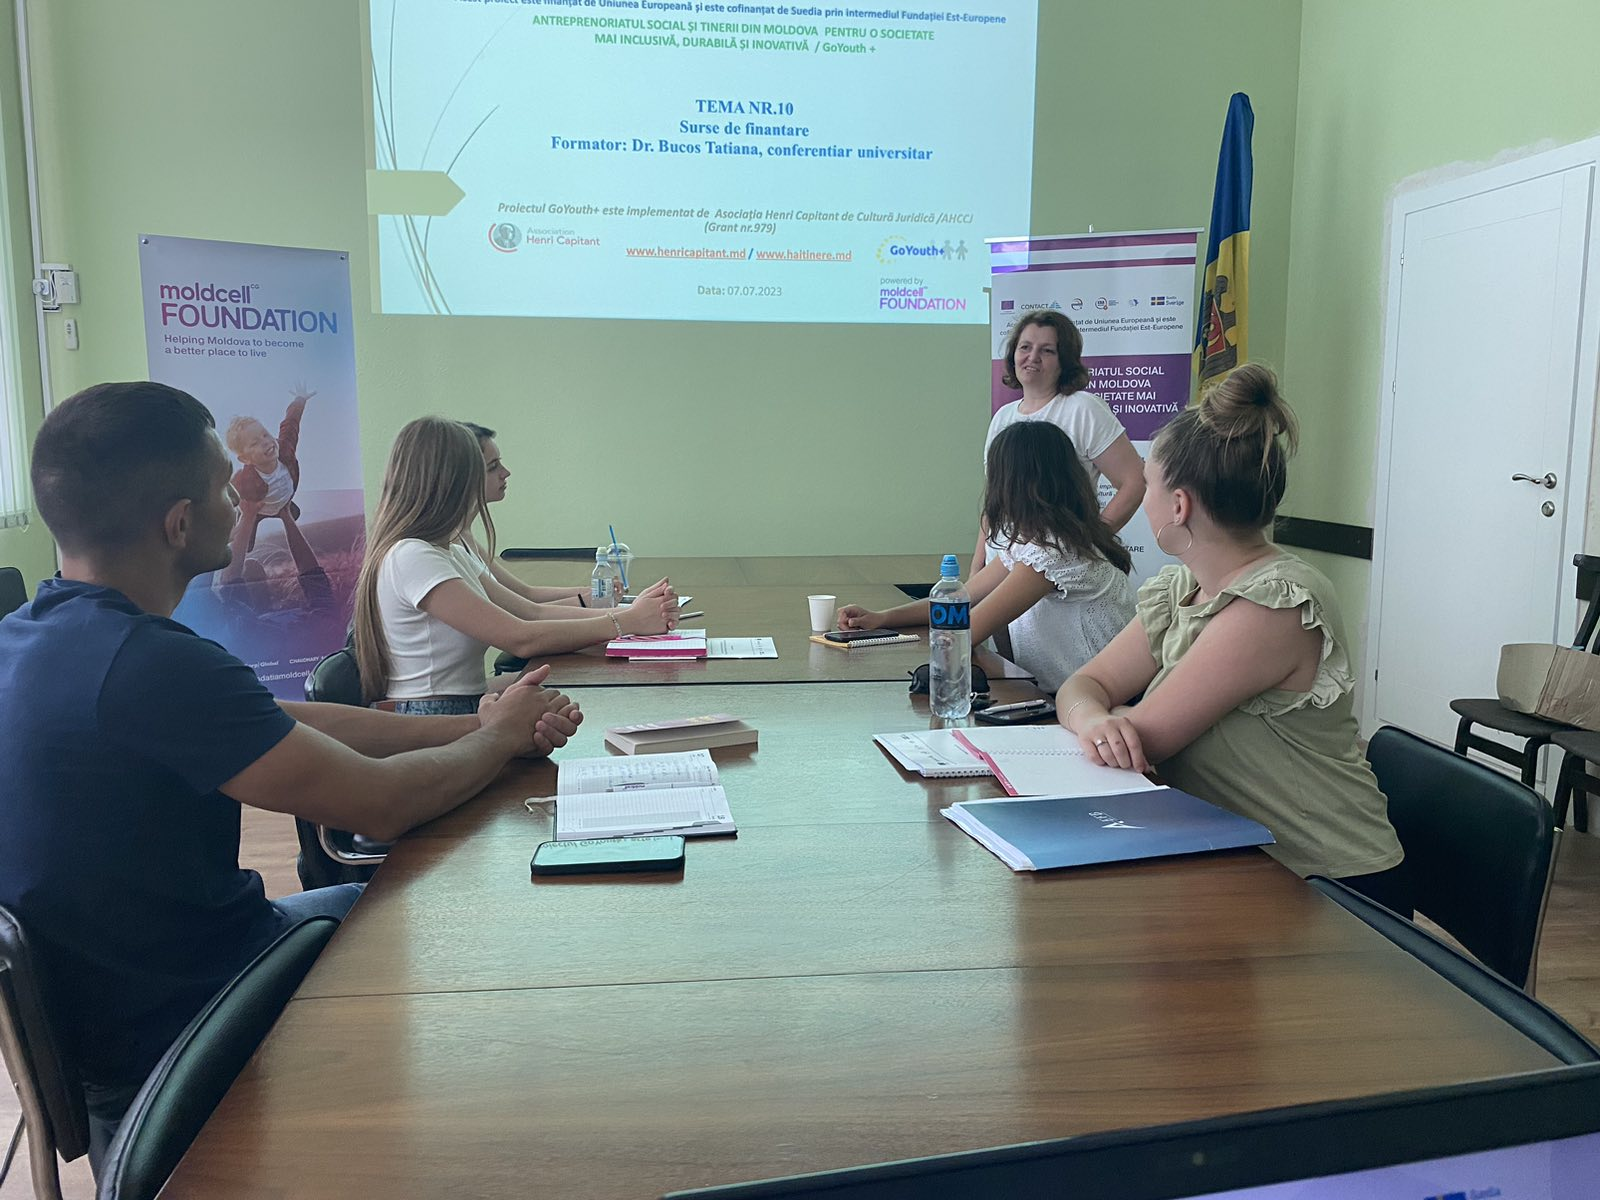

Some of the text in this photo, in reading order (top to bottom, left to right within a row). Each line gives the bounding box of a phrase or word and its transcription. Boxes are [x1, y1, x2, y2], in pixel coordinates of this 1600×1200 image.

[599, 0, 639, 9] Uniunea
[641, 0, 692, 12] Europeană
[704, 5, 725, 13] este
[777, 6, 789, 15] de
[791, 6, 822, 17] Suedia
[825, 8, 844, 19] prin
[846, 8, 899, 20] intermediul
[946, 13, 1007, 25] Est-Europene
[532, 15, 645, 30] ANTREPRENORIATUL
[647, 19, 686, 31] SOCIAL
[700, 22, 739, 33] TINERII
[741, 24, 761, 34] DIN
[764, 24, 818, 36] MOLDOVA
[825, 27, 867, 38] PENTRU
[870, 28, 878, 39] O
[880, 29, 935, 41] SOCIETATE
[594, 33, 618, 44] MAI
[683, 36, 737, 49] DURABILĂ
[752, 39, 809, 52] INOVATIVĂ
[822, 42, 867, 54] GoYouth
[695, 99, 794, 116] TEMA NR.10
[679, 120, 810, 137] Surse de finantare
[551, 136, 933, 161] Formator: Dr. Bucos Tatiana, conferentiar universitar
[497, 203, 546, 215] Proiectul
[548, 204, 599, 216] GoYouth+
[602, 206, 625, 216] este
[627, 206, 694, 219] implementat
[696, 208, 710, 218] de
[765, 210, 793, 221] Henri
[795, 210, 840, 223] Capitant
[841, 211, 854, 222] de
[856, 212, 895, 223] Cultură
[895, 212, 935, 224] Juridică
[526, 227, 576, 236] Association
[704, 222, 777, 235] (Grant nr.979)
[526, 235, 600, 247] Henri Capitant
[626, 247, 746, 260] www.henricapitant.md
[756, 249, 852, 262] www.haitinere.md
[880, 277, 923, 287] powered by
[160, 283, 250, 304] moldcell
[697, 285, 782, 297] Data: 07.07.2023
[880, 287, 923, 297] moldcell
[880, 298, 966, 311] FOUNDATION
[161, 302, 338, 334] FOUNDATION
[164, 334, 304, 348] Helping Moldova to become
[174, 346, 205, 355] better
[208, 347, 236, 358] place
[238, 348, 248, 357] to
[250, 349, 267, 358] live
[1088, 366, 1164, 376] RIATUL SOCIAL
[1099, 379, 1151, 389] MOLDOVA
[1136, 391, 1156, 400] MAI
[1125, 402, 1178, 413] INOVATIVĂ
[931, 604, 968, 624] OM
